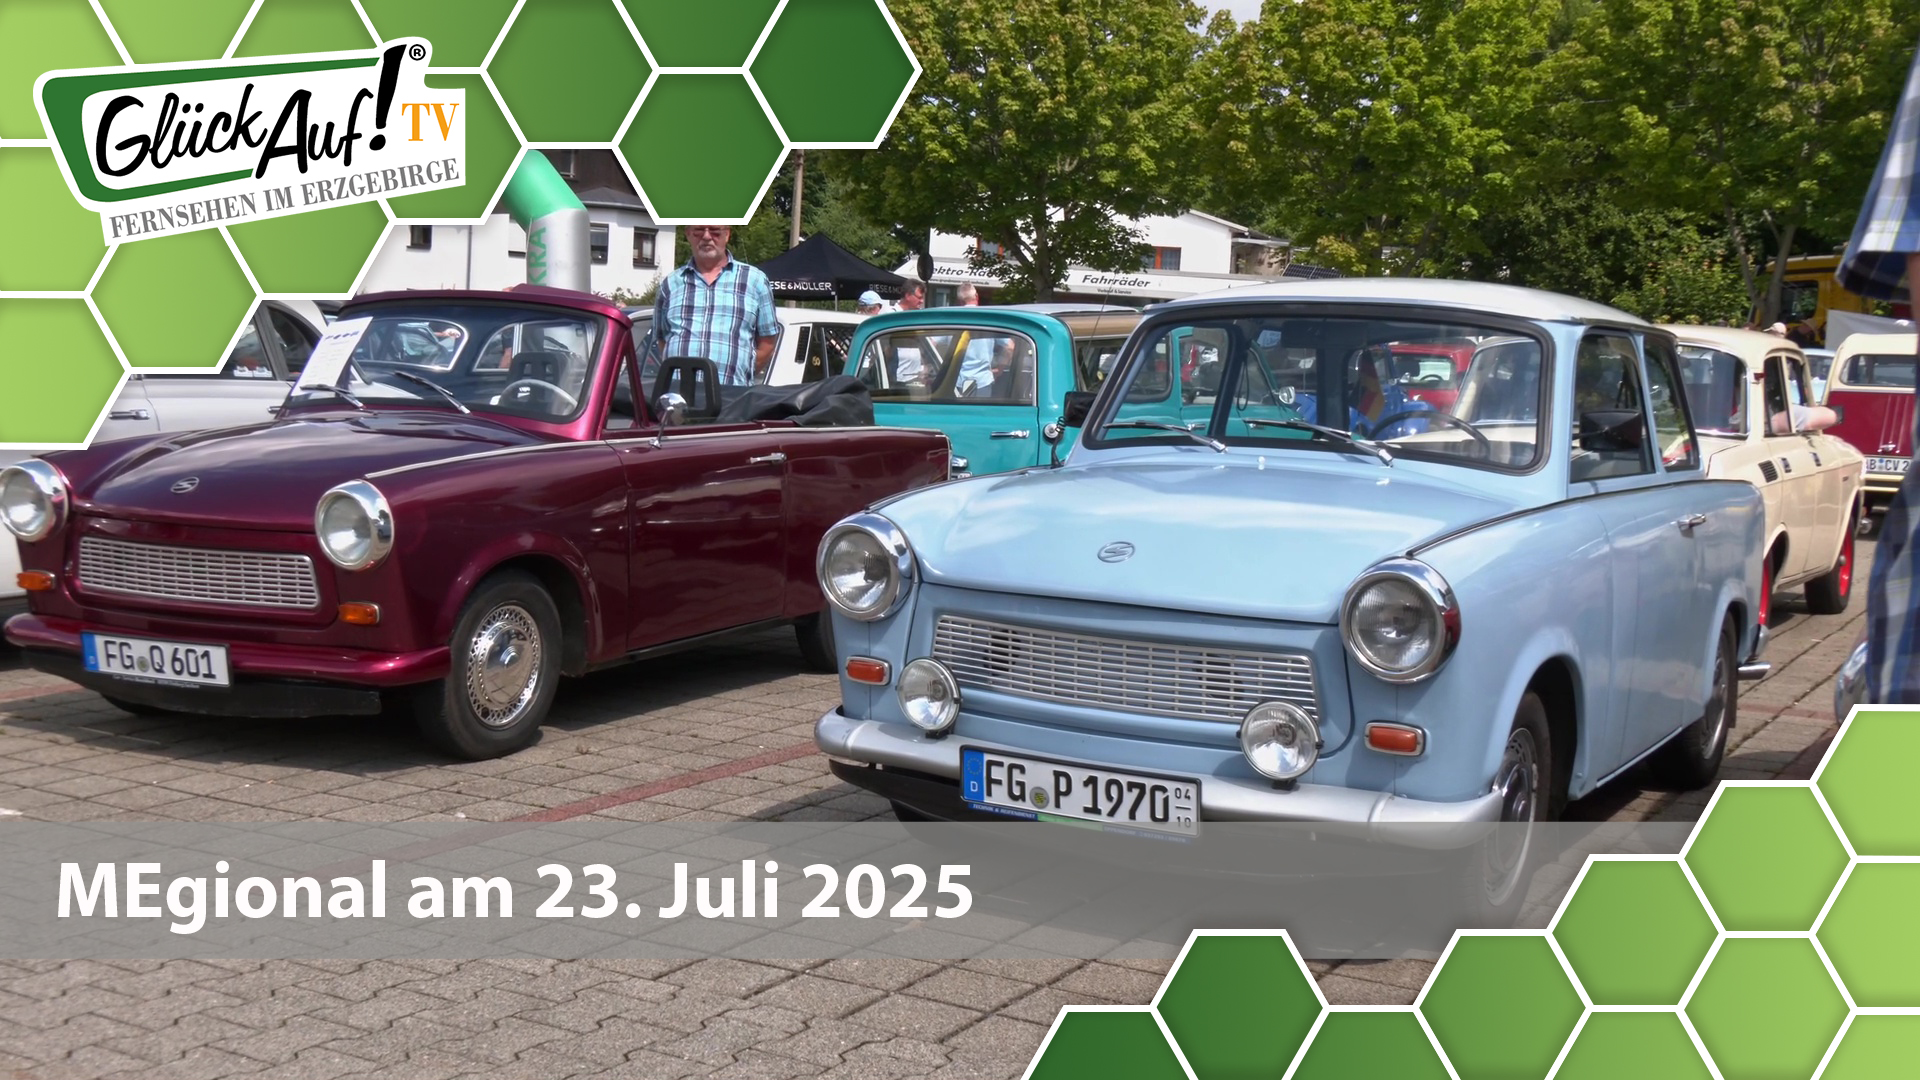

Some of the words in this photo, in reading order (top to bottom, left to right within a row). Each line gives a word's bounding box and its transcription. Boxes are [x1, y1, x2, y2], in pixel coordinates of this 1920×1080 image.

[1082, 274, 1151, 288] Fahrräder
[1885, 459, 1900, 471] CV
[104, 640, 135, 670] FG
[150, 645, 166, 674] Q
[171, 647, 216, 679] 601
[970, 781, 979, 792] D
[985, 759, 1026, 803] FG
[1053, 770, 1073, 809] P
[1083, 775, 1169, 823] 1970
[1175, 787, 1191, 801] 04
[1177, 815, 1191, 828] 10
